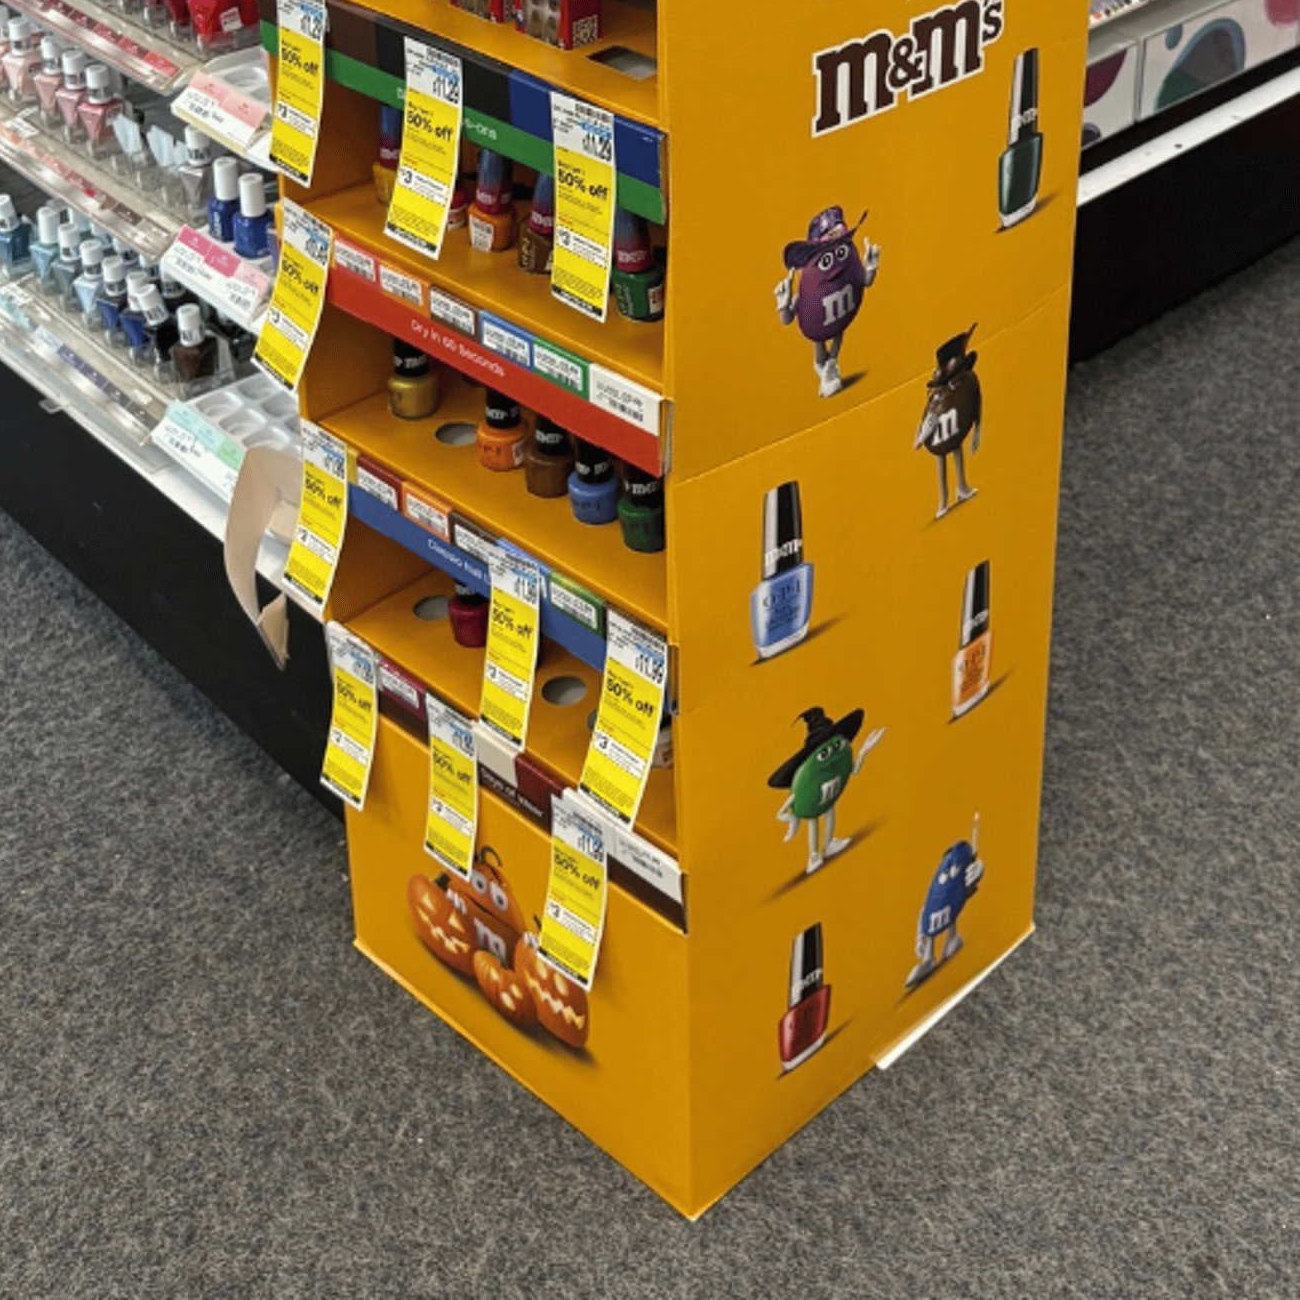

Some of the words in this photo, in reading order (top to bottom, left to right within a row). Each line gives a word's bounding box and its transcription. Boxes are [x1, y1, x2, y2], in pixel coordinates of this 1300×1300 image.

[407, 110, 433, 133] 50%
[822, 281, 857, 326] m
[411, 318, 429, 339] Dry
[459, 343, 505, 377] Seconds
[931, 407, 959, 447] m
[606, 677, 634, 706] 50%
[820, 776, 842, 805] m
[929, 905, 953, 933] m
